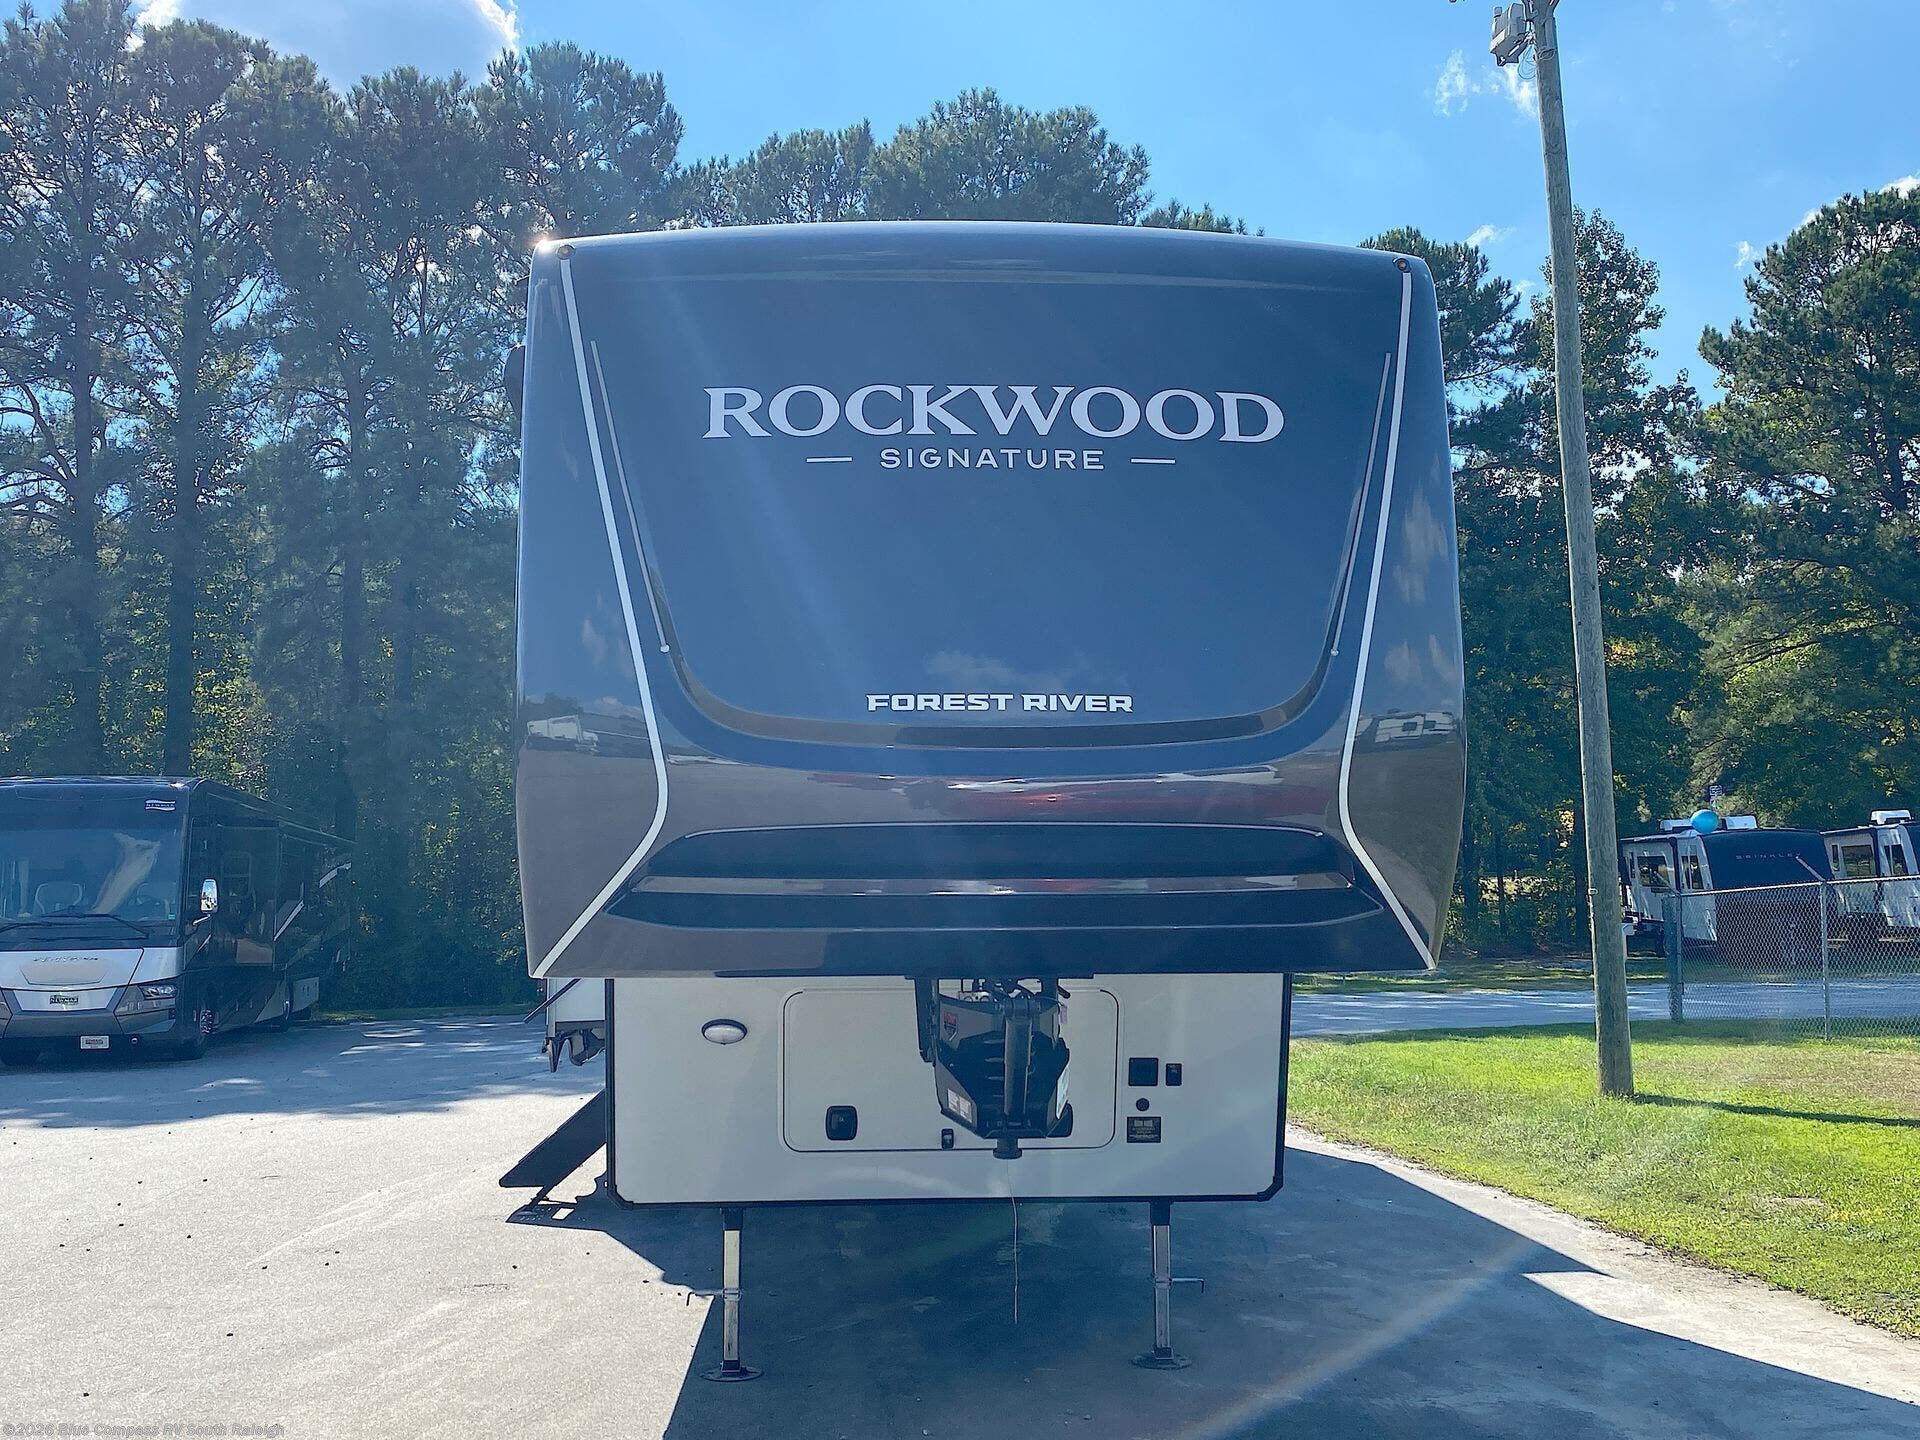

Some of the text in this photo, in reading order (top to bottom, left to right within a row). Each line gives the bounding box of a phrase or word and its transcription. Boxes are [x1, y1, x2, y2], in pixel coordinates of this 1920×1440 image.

[703, 384, 1285, 443] ROCKWOOD
[880, 448, 1105, 470] SIGNATURE
[866, 693, 1134, 713] FOREST RIVER
